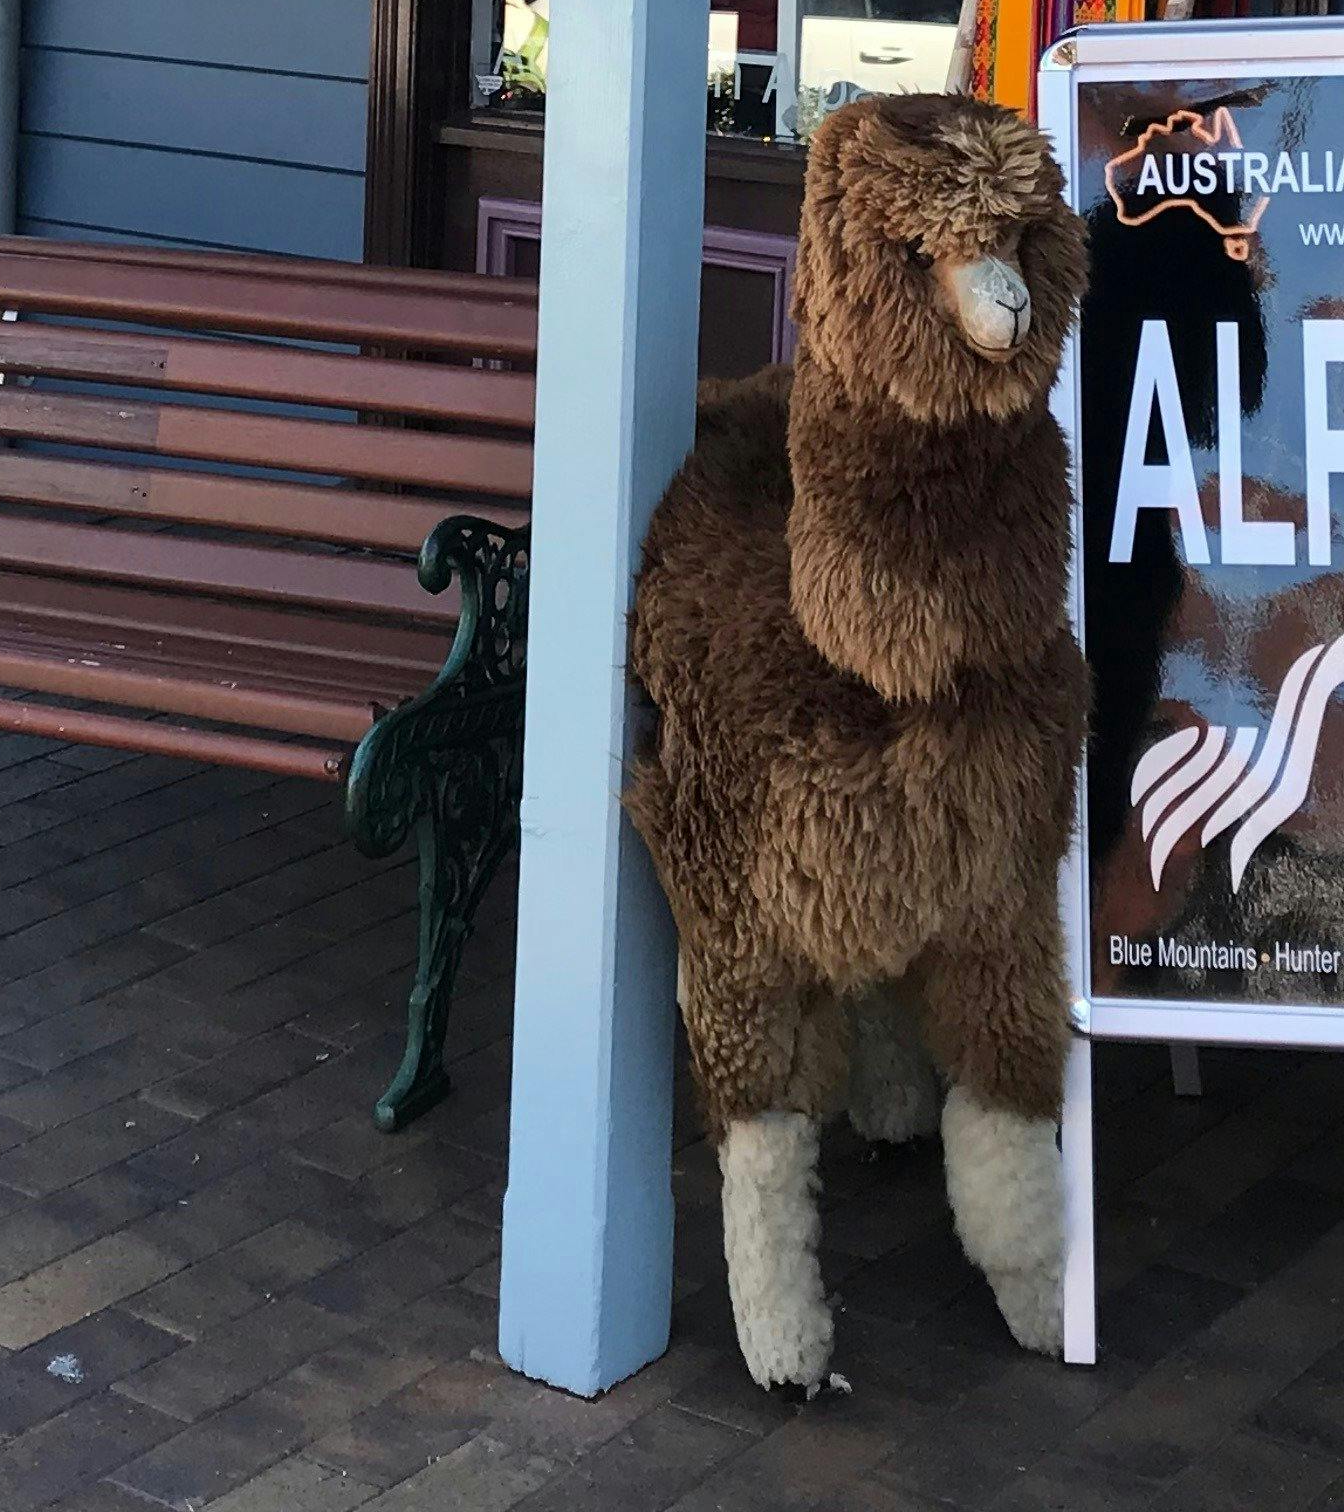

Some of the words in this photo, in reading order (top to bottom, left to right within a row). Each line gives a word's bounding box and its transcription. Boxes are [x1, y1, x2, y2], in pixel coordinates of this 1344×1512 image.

[1110, 935, 1153, 966] Blue
[1158, 937, 1257, 971] Mountains
[1275, 941, 1341, 974] Hunter
